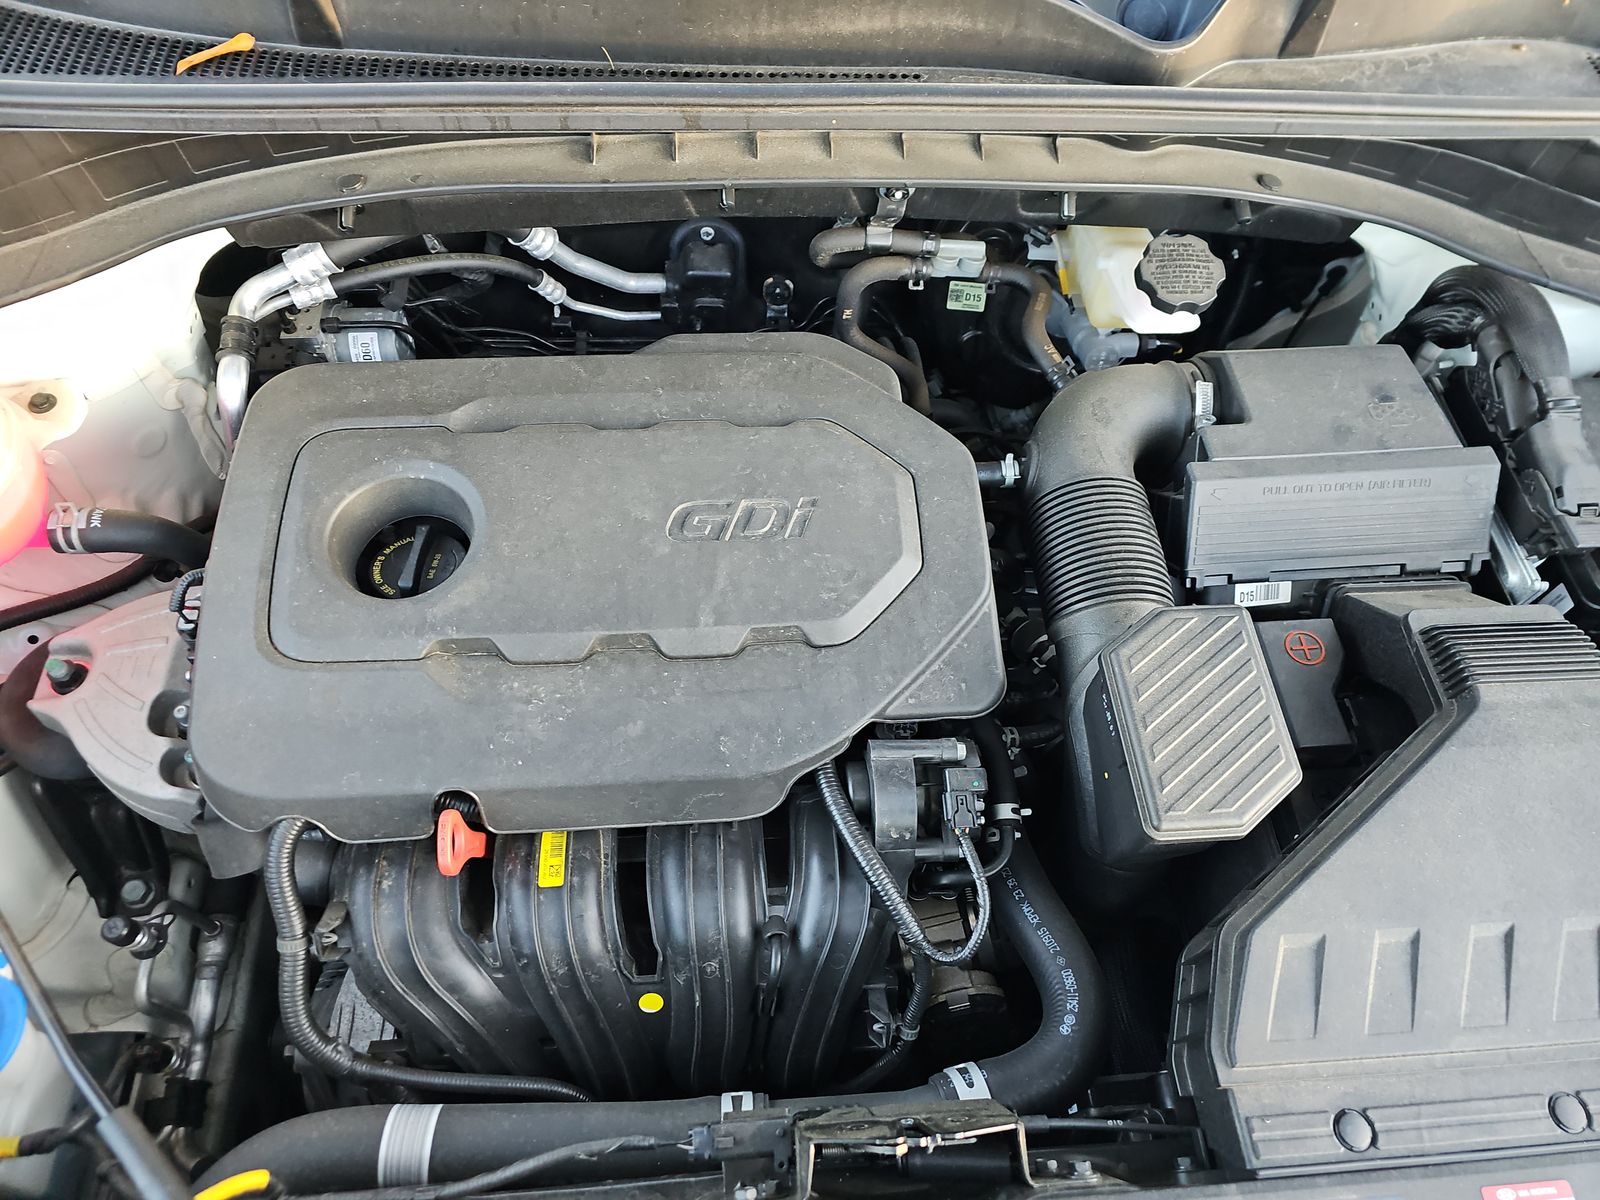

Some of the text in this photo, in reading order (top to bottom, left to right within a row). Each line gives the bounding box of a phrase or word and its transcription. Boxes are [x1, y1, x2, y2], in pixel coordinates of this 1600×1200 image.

[965, 292, 982, 303] D15
[360, 342, 373, 361] D60
[1262, 486, 1289, 496] PULL
[1292, 484, 1314, 494] OUT
[1319, 483, 1333, 493] TO
[1334, 481, 1364, 492] OPEN
[89, 508, 107, 528] ANK
[372, 555, 386, 584] OWNER'S
[379, 583, 396, 596] SEE
[1239, 590, 1255, 603] D15
[1037, 927, 1061, 954] 210915
